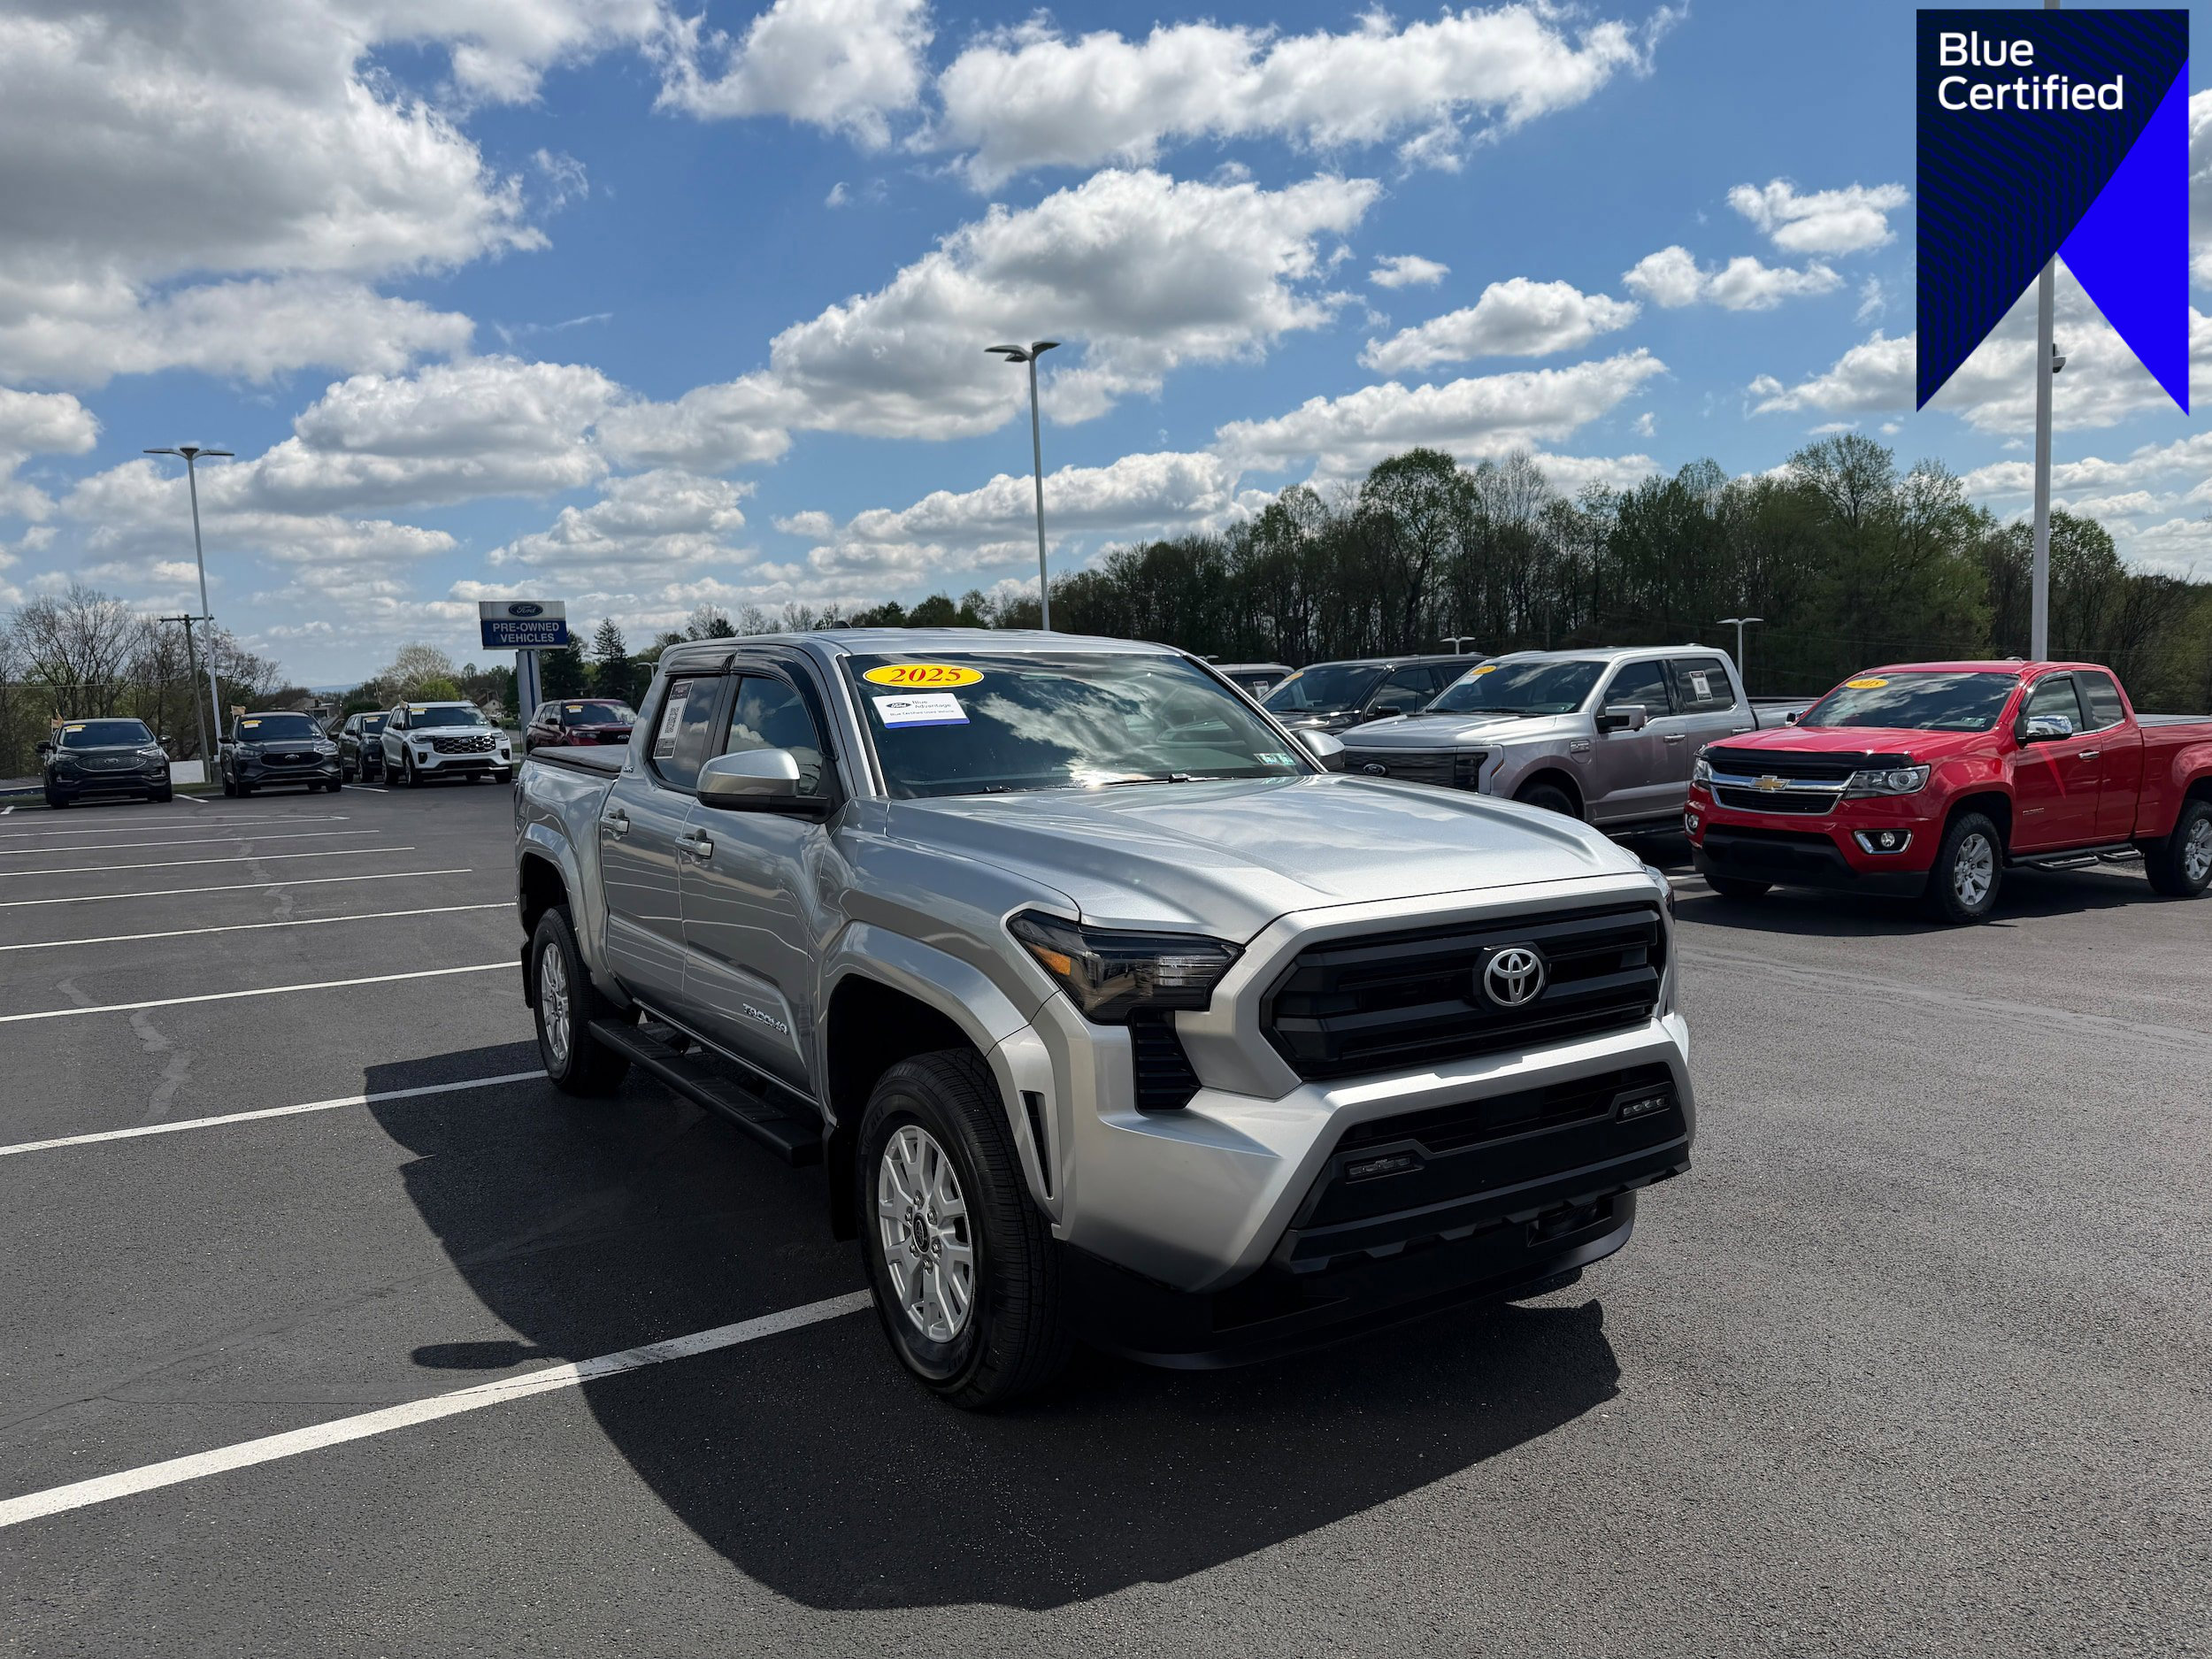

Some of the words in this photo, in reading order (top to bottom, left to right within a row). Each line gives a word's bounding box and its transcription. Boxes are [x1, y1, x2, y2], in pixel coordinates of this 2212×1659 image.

[516, 605, 537, 614] Ford
[492, 622, 560, 633] PRE-OWNED
[500, 633, 556, 643] VEHICLES
[888, 668, 963, 682] 2025
